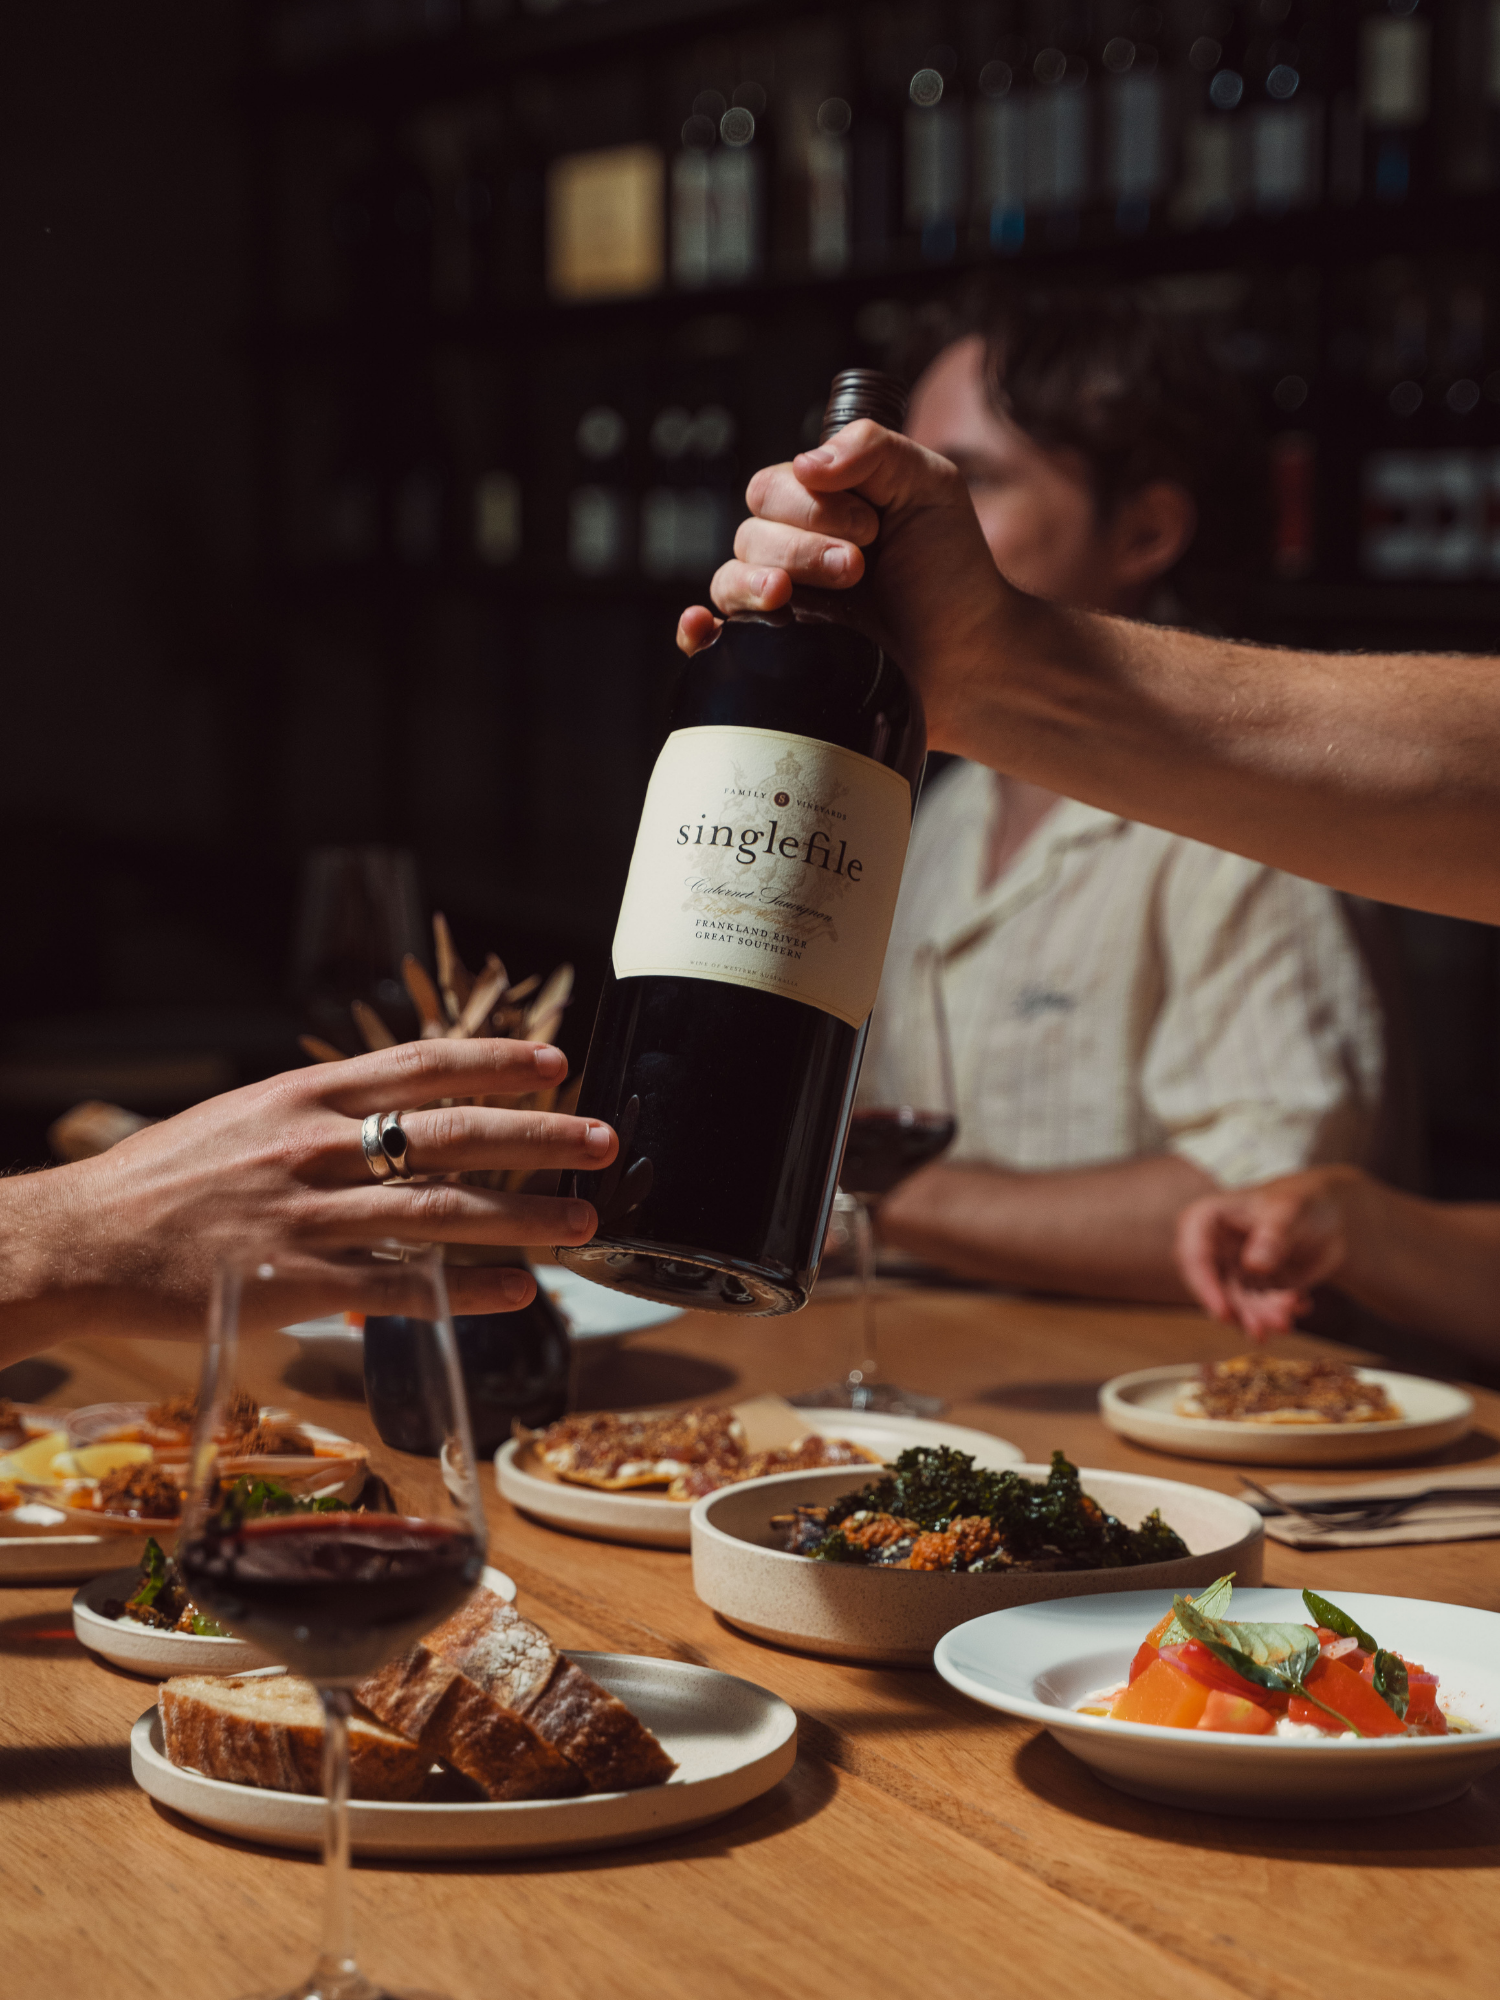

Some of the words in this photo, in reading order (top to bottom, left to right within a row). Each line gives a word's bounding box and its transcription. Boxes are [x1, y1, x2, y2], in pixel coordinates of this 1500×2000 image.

[724, 787, 767, 799] FAMILY
[796, 799, 847, 820] VINEYARDS
[676, 813, 863, 882] singlefile
[684, 876, 755, 899] Cabernet
[758, 887, 833, 923] Sauvignon
[695, 919, 768, 938] FRANKLAND
[773, 932, 808, 949] RIVER
[695, 931, 734, 943] GREAT
[738, 937, 803, 960] SOUTHERN
[724, 964, 757, 975] WESTERN
